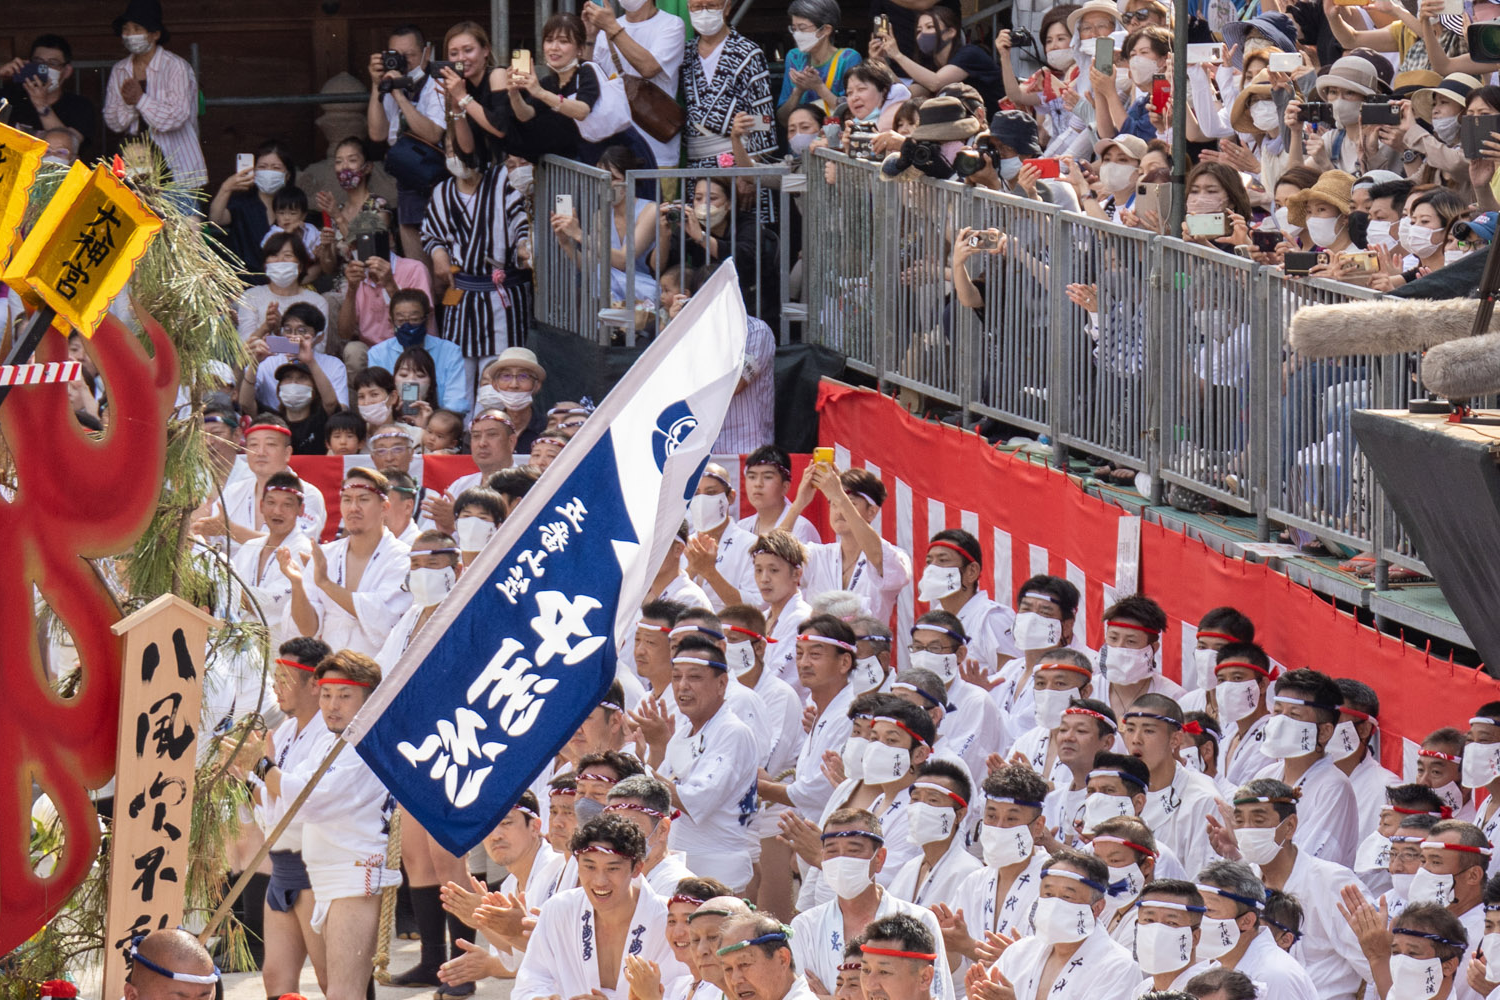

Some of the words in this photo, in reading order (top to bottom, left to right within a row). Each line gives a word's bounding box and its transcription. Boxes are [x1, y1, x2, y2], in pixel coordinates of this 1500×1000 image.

[56, 204, 121, 302] 大神宮
[1425, 967, 1436, 994] 千代流
